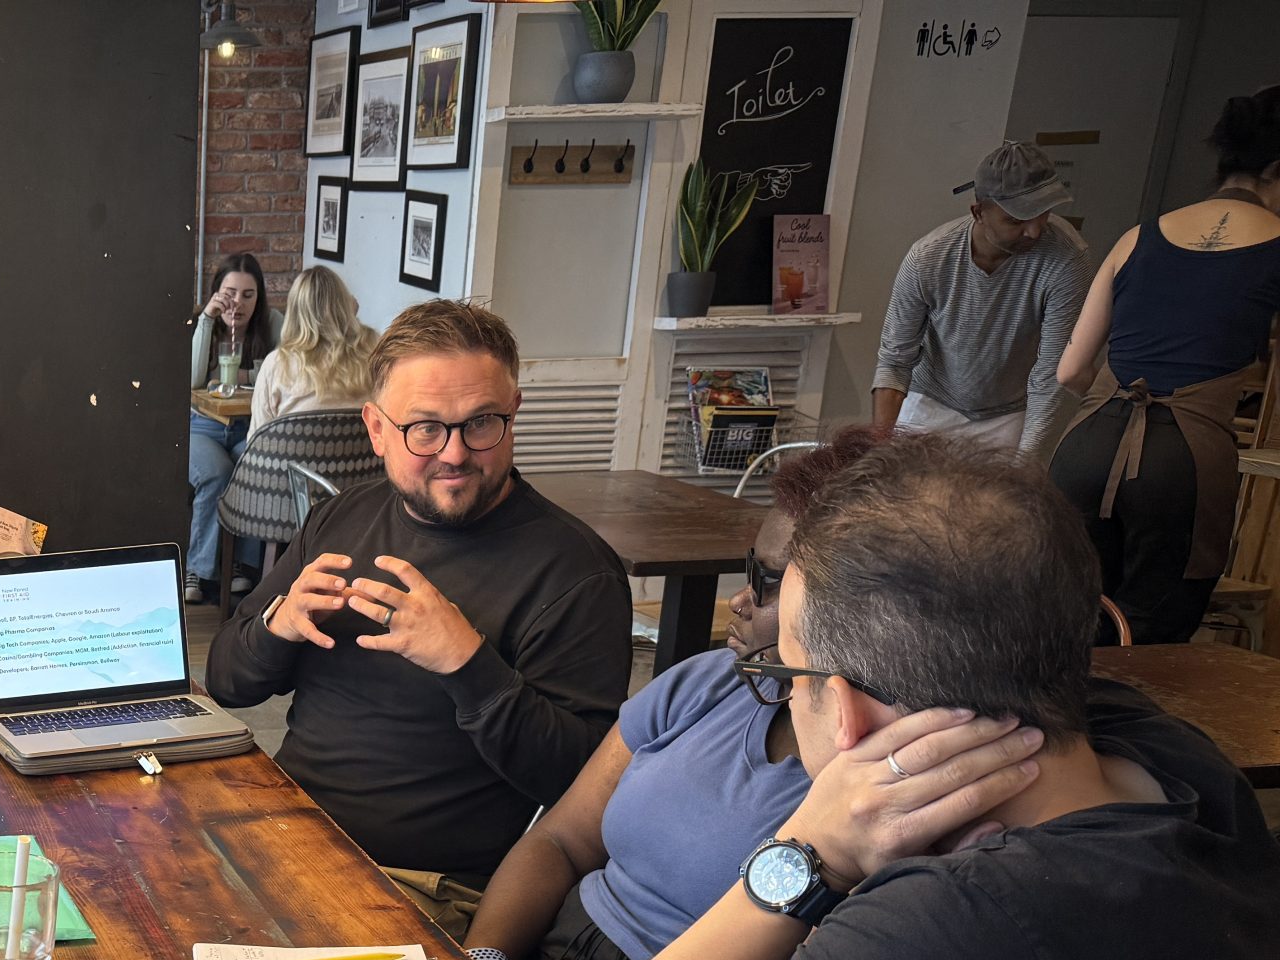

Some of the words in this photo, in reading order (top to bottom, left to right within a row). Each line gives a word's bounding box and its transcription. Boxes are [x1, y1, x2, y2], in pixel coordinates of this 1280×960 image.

[724, 46, 810, 123] Toilet
[790, 218, 811, 231] Cool
[777, 232, 797, 249] fruit
[797, 232, 825, 244] blends
[727, 428, 754, 441] BIG
[25, 626, 56, 634] Companies
